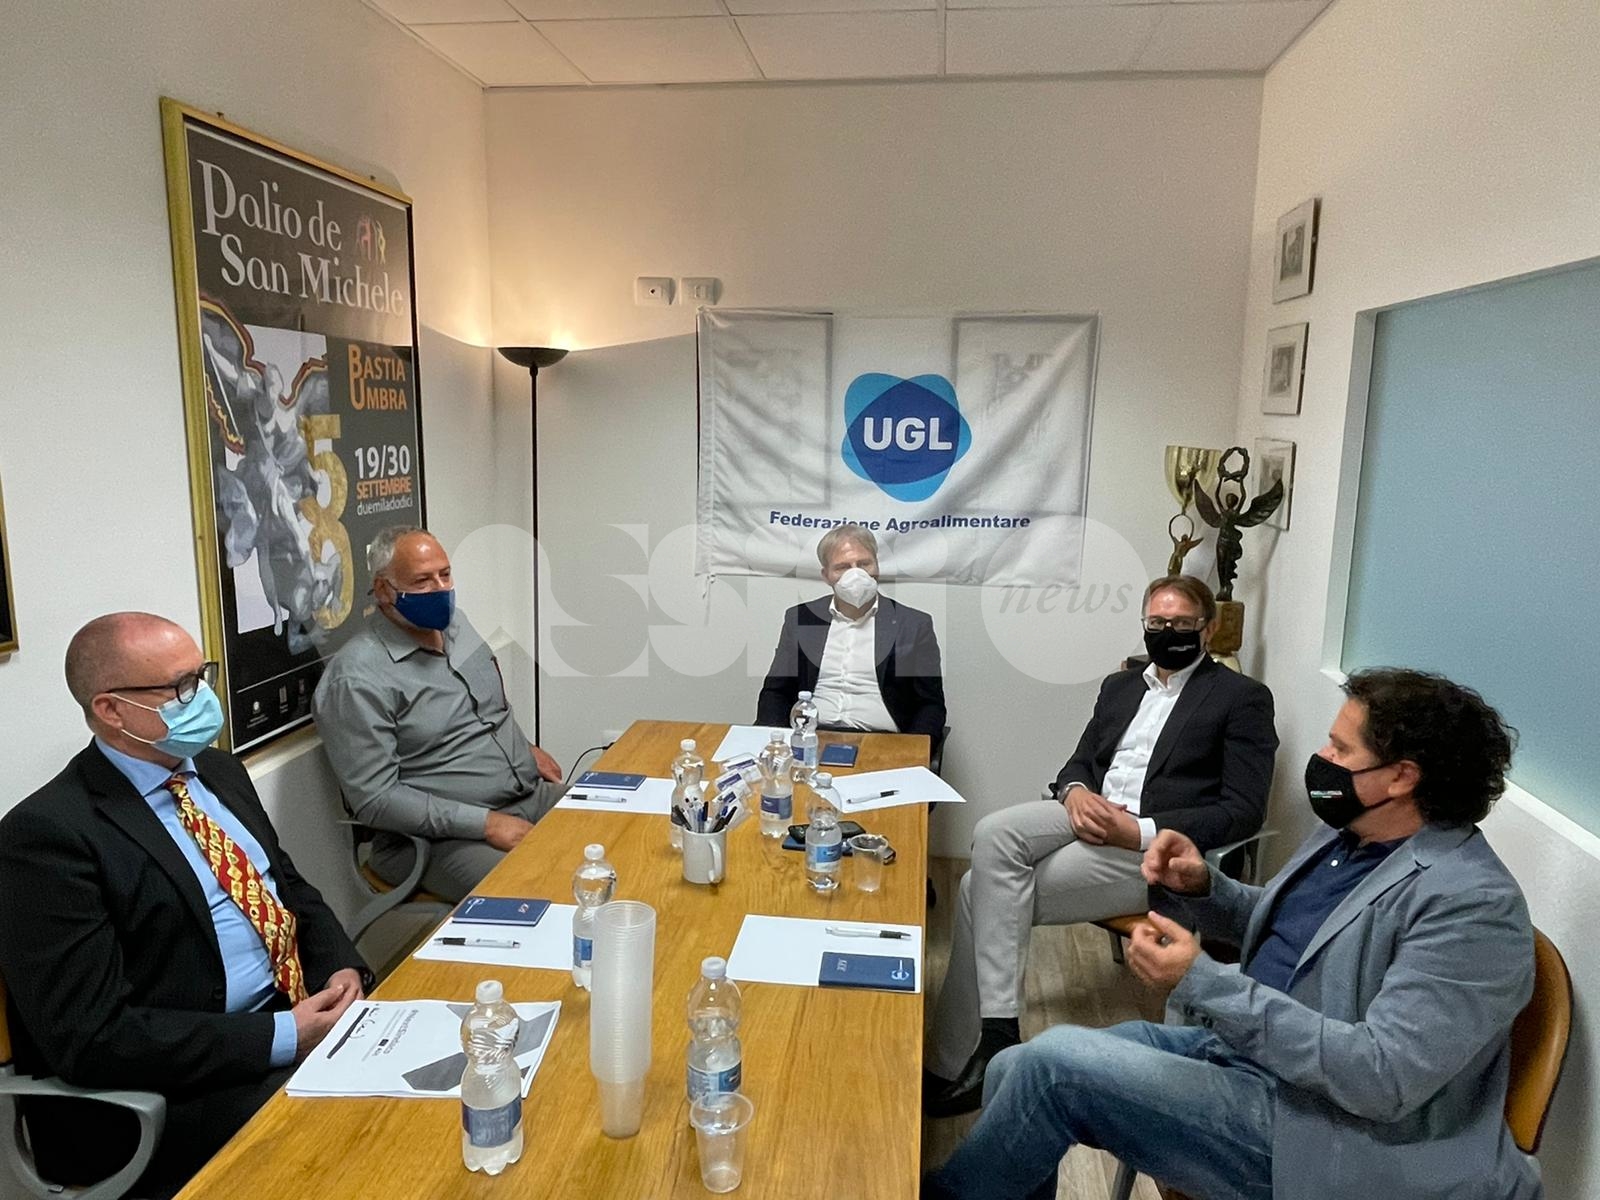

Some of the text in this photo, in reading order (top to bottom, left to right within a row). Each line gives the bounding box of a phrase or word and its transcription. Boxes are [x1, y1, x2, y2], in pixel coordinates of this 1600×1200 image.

[197, 159, 342, 251] Palio de
[220, 234, 404, 316] San Michele
[863, 417, 953, 451] UGL
[355, 444, 411, 480] 19/30
[356, 476, 413, 501] SETTEMBRE
[357, 496, 414, 517] duemiladodici
[885, 514, 1031, 533] Agroalimentare
